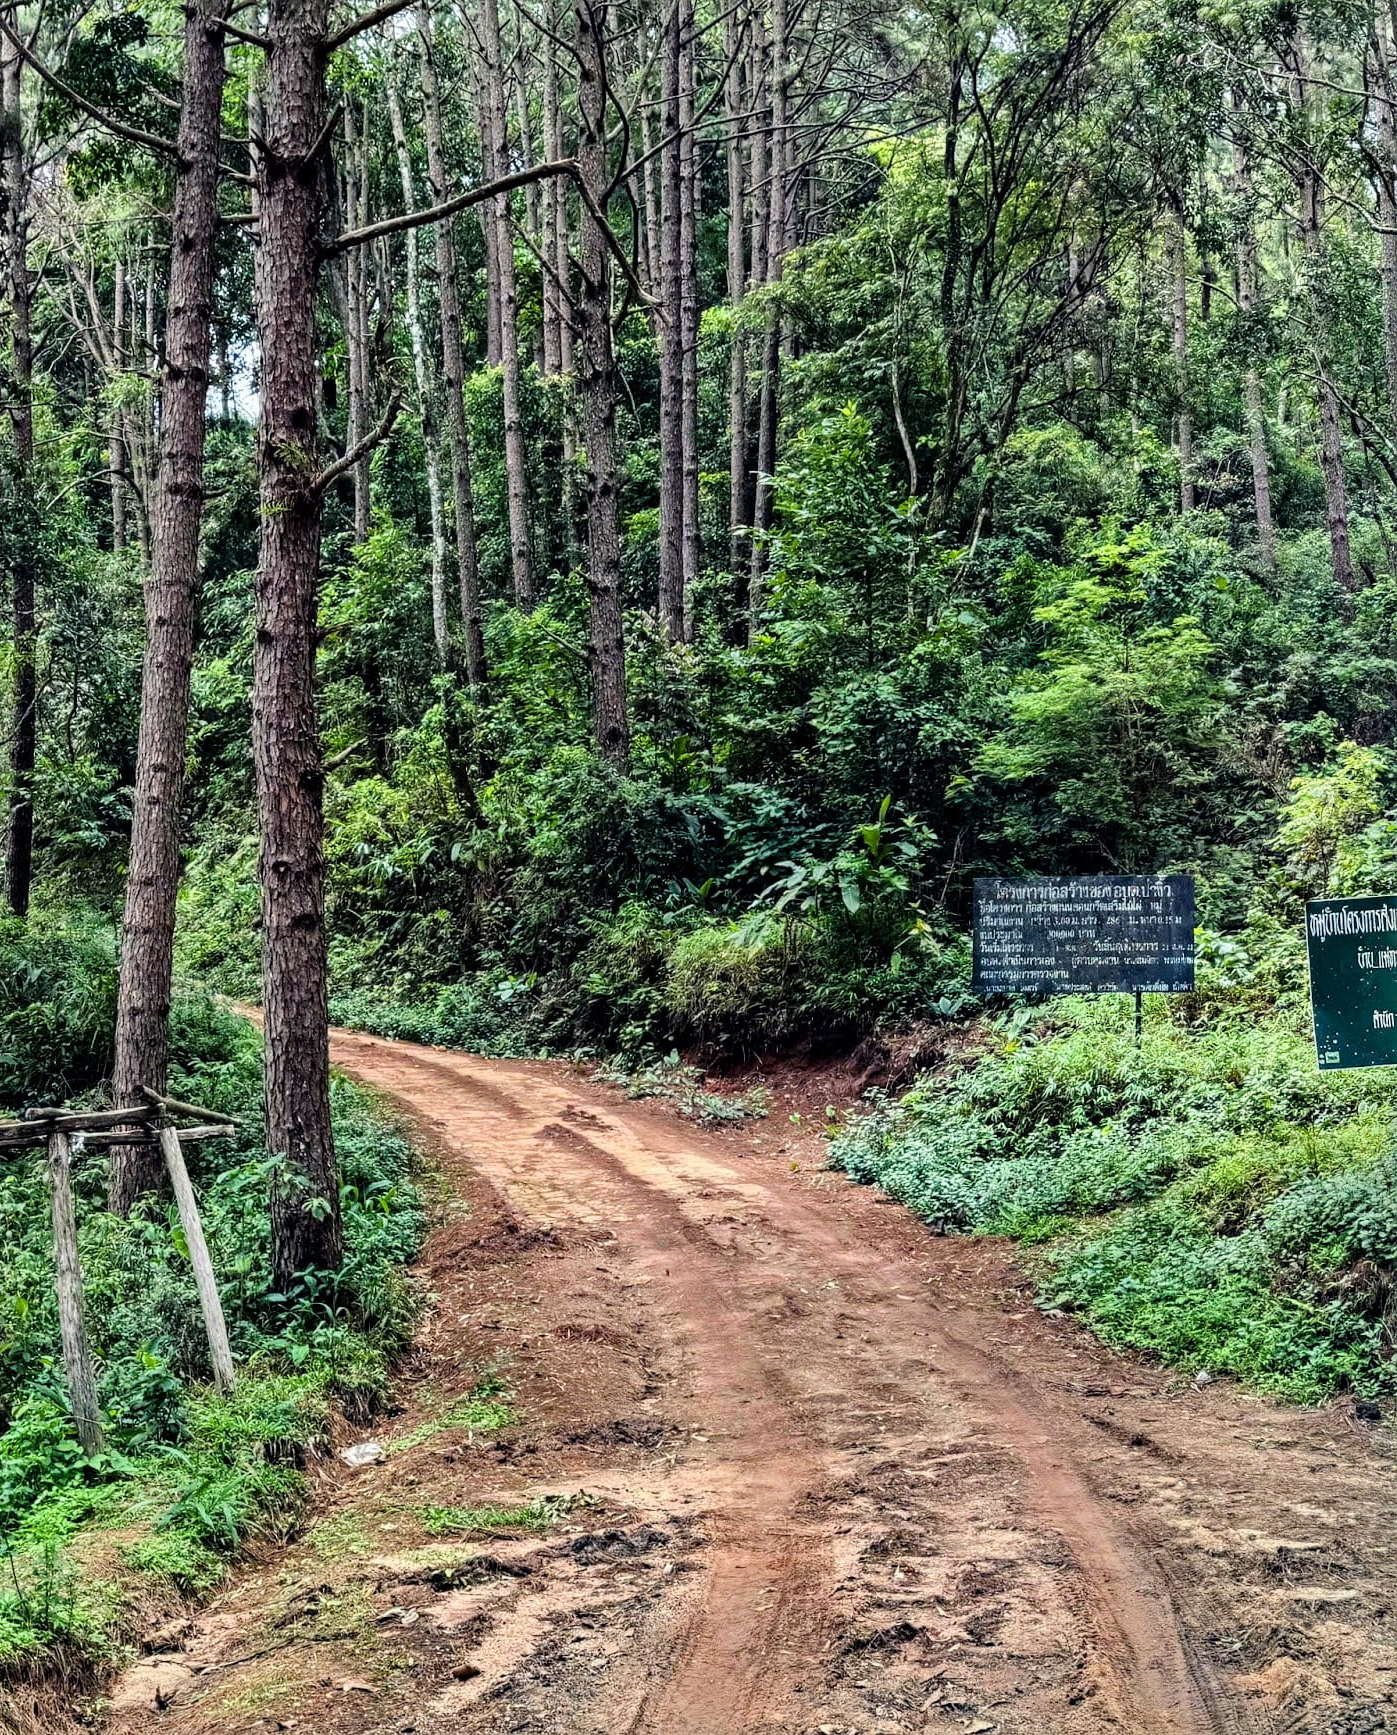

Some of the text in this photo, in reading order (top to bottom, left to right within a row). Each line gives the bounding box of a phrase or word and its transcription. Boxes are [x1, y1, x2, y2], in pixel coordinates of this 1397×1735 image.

[1310, 903, 1397, 942] หมู่บ้านโครงการส่งเ
[1372, 1009, 1397, 1029] สำนัก
